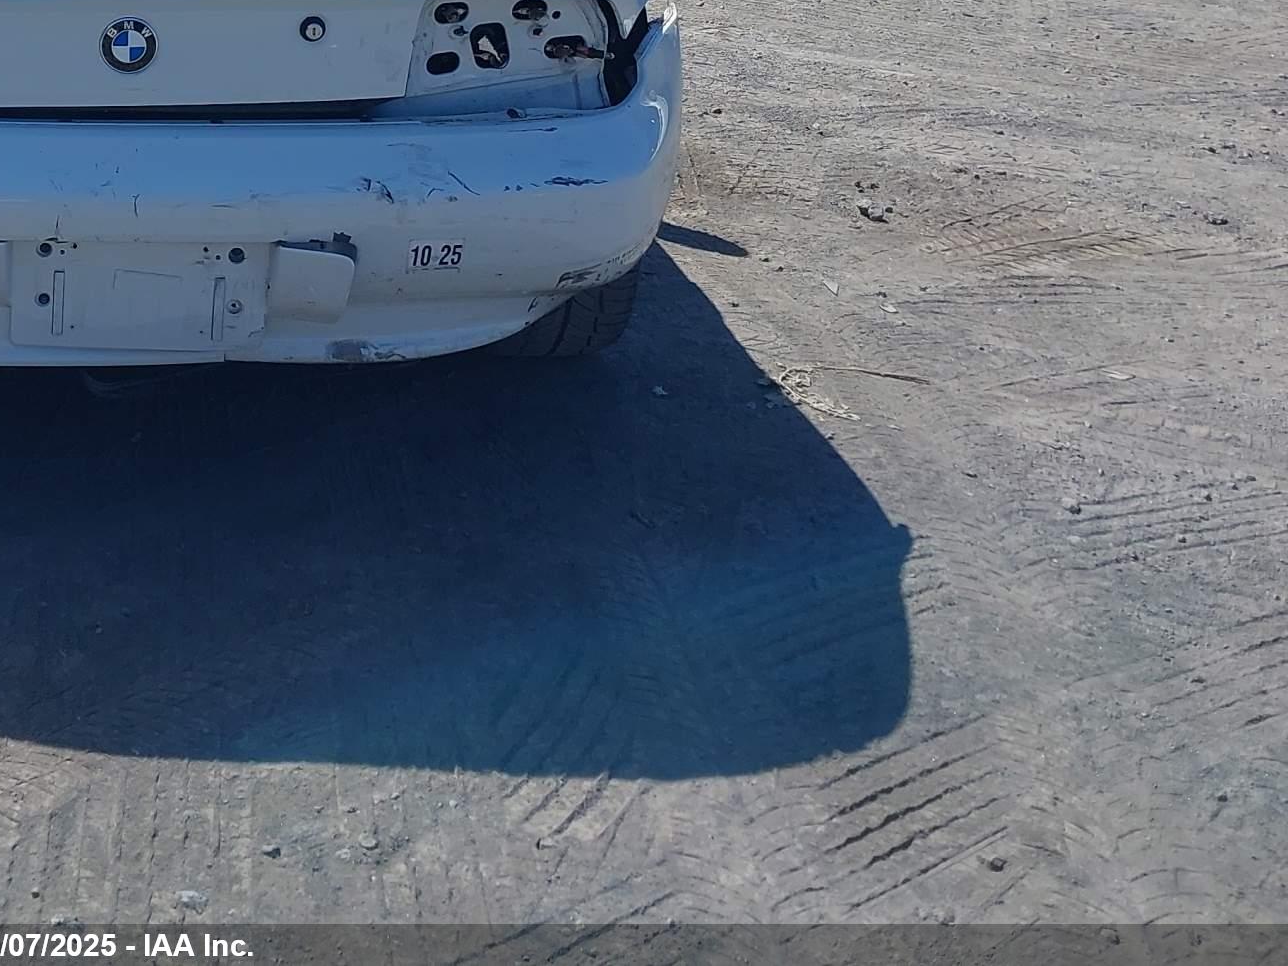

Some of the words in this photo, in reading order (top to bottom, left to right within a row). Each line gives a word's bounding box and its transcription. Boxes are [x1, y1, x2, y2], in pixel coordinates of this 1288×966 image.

[107, 20, 152, 38] BMW
[410, 245, 432, 266] 10
[438, 244, 463, 266] 25
